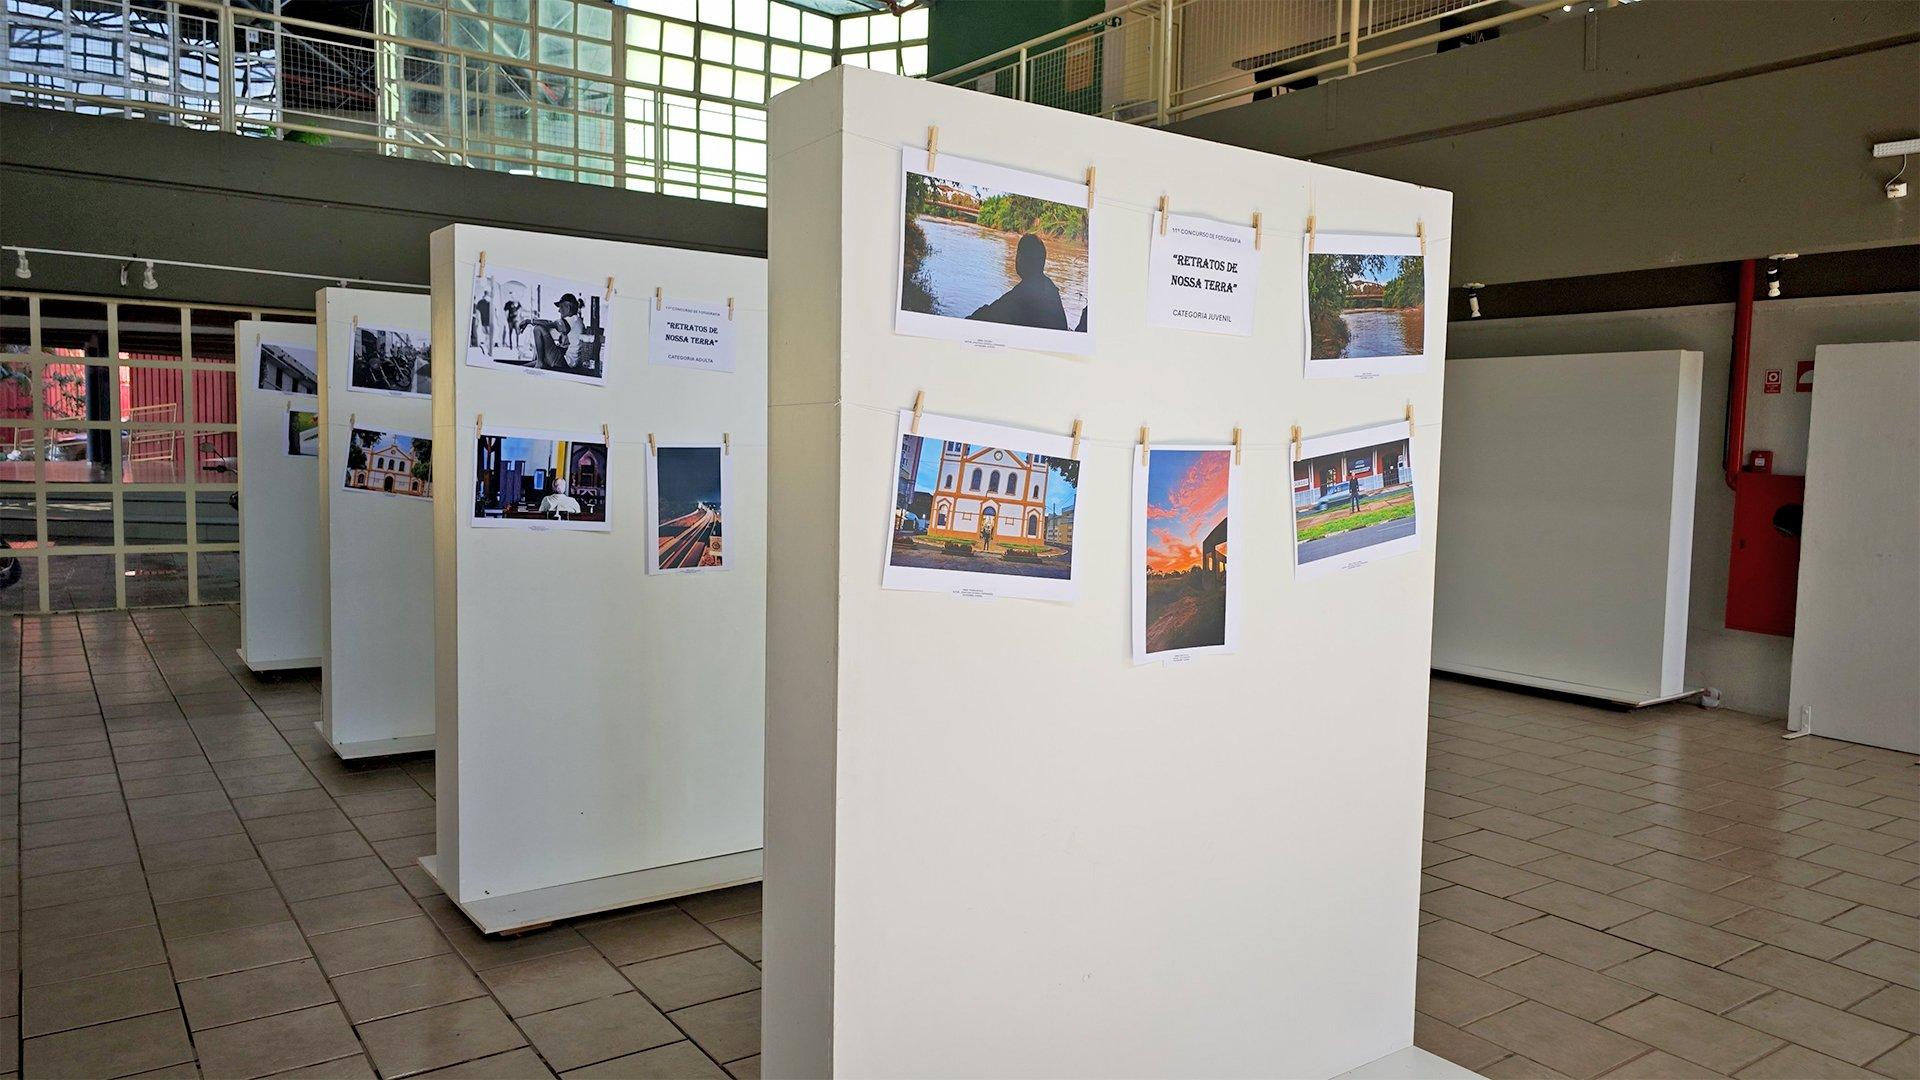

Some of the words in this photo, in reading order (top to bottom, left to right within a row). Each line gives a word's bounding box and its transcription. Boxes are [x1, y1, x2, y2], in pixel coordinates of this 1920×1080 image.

[1181, 229, 1208, 238] CONCURSO
[1226, 262, 1238, 273] DE
[1171, 275, 1202, 288] NOSSA
[1172, 309, 1208, 320] CATEGORIA
[1208, 313, 1232, 322] JUVENIL
[665, 334, 689, 343] NOSSA
